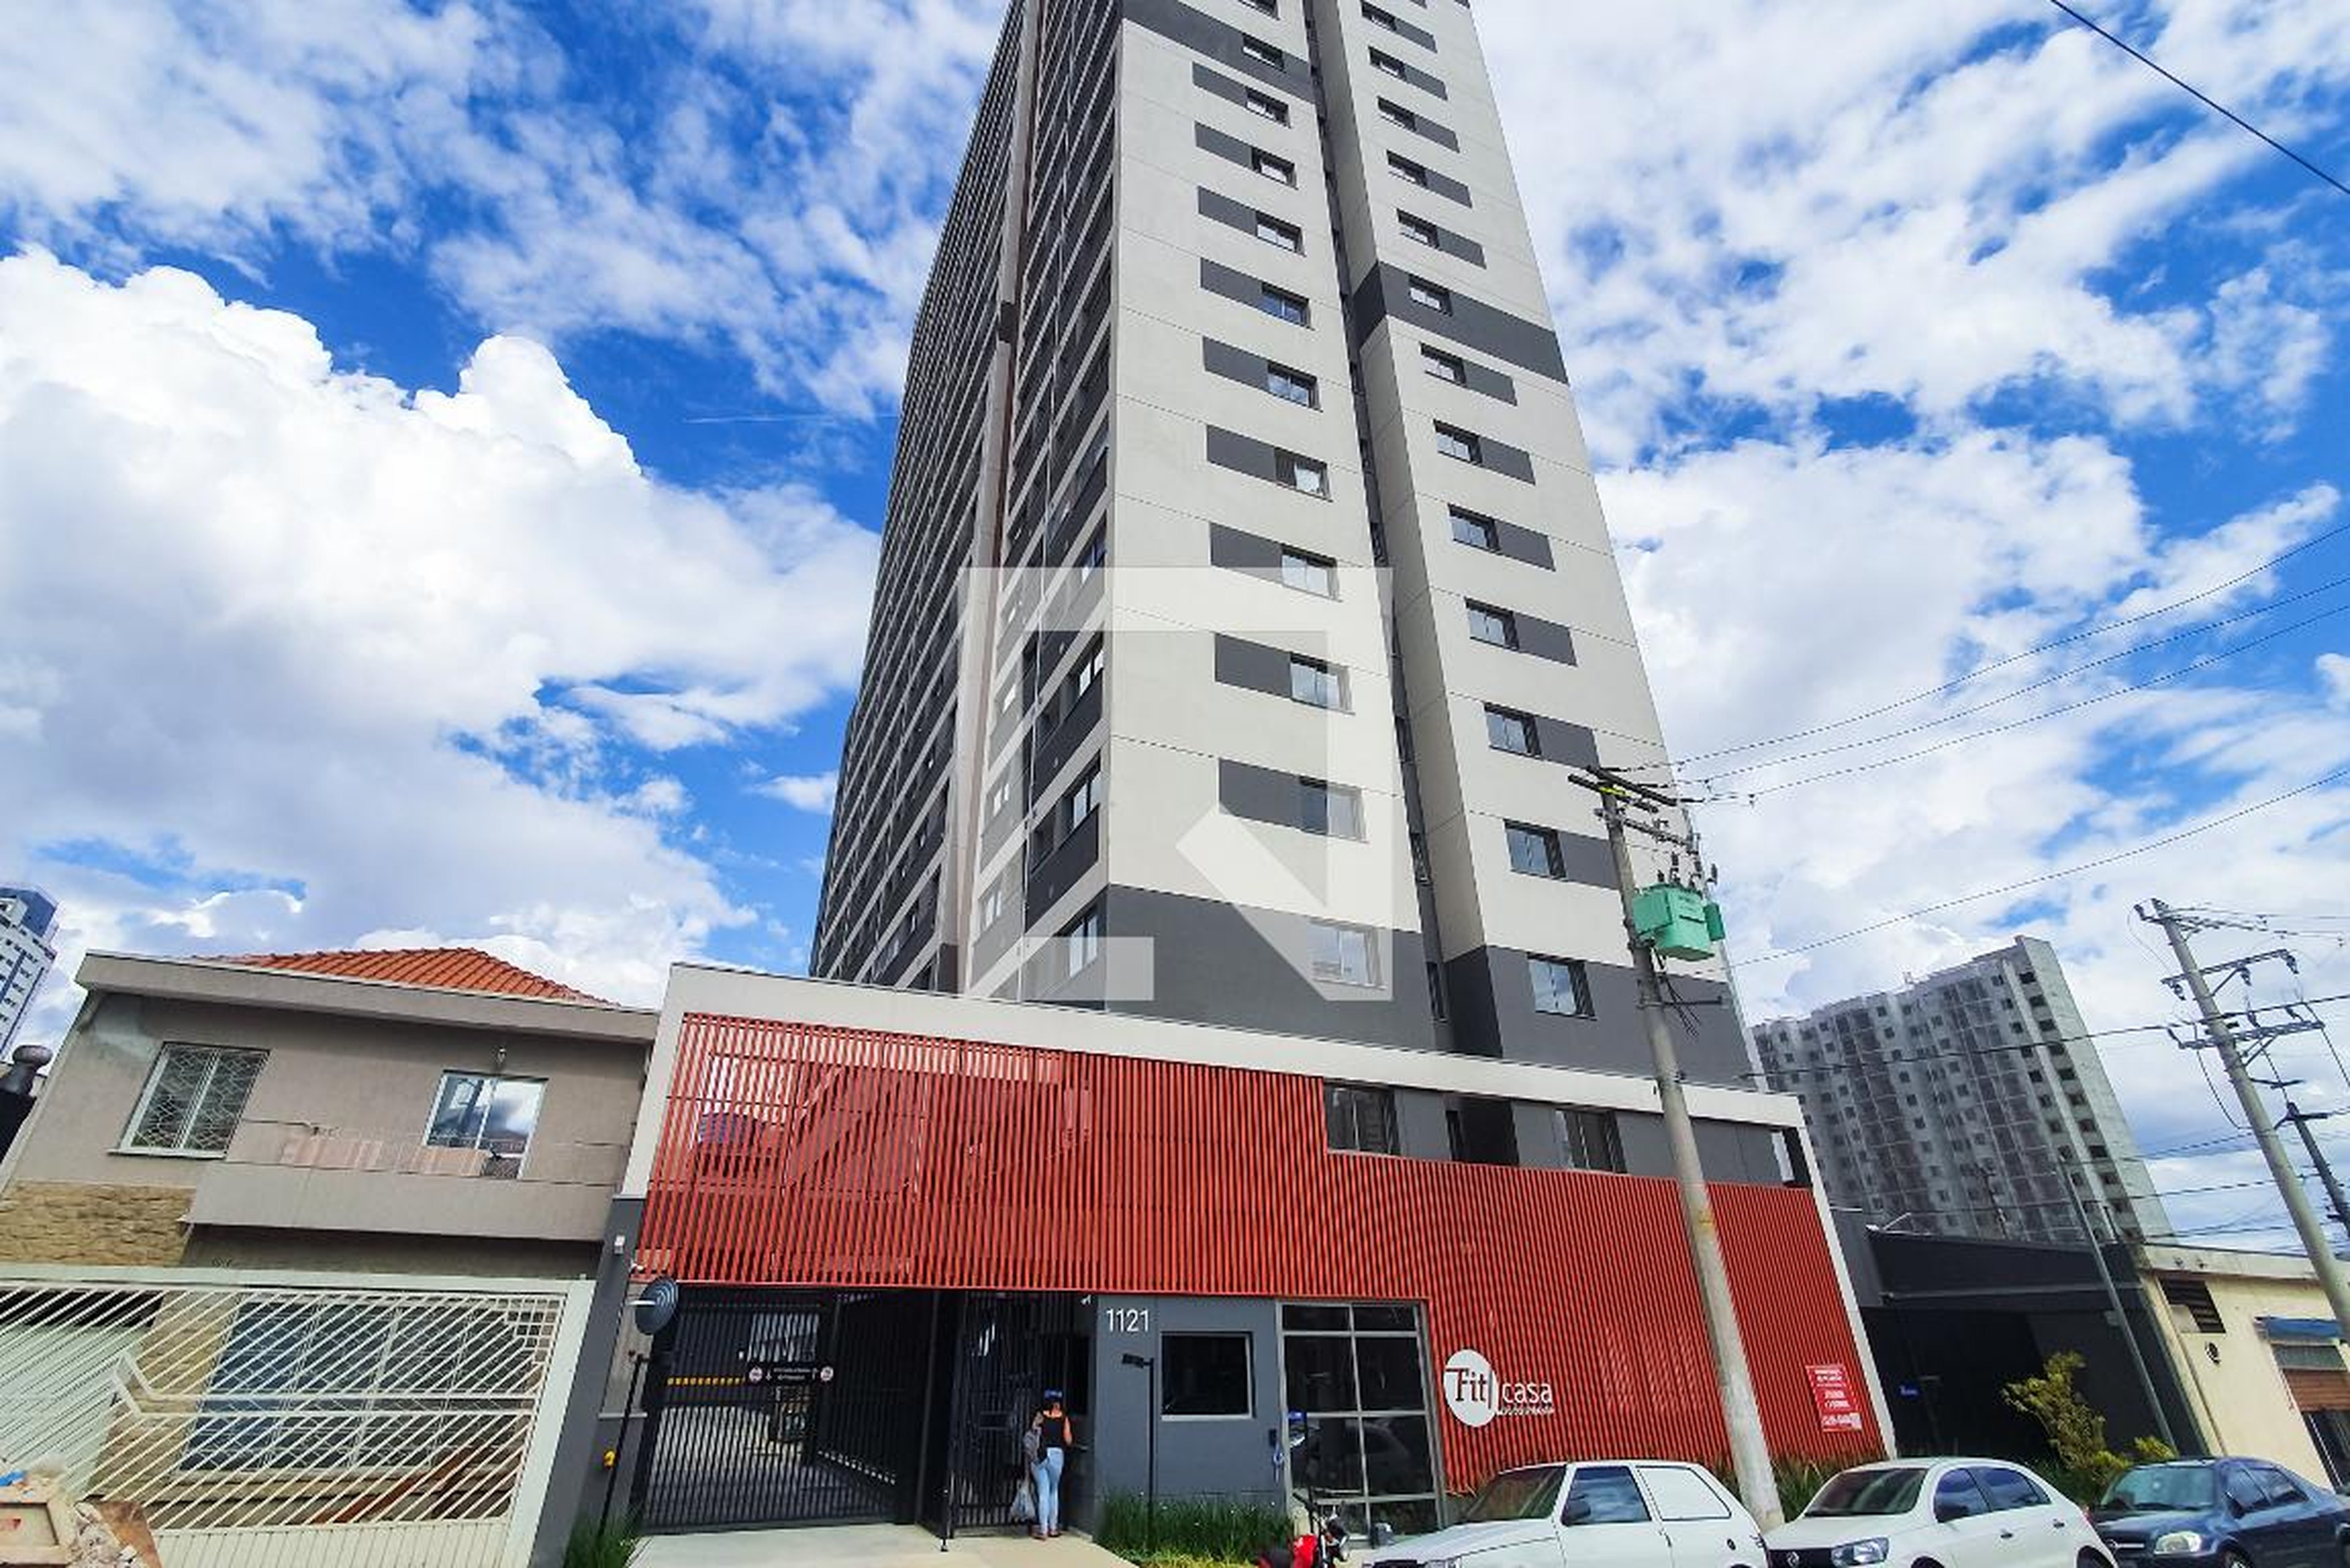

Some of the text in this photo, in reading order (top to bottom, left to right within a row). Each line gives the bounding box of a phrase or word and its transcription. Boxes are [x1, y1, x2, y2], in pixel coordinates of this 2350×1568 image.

[1106, 1308, 1149, 1332] 1121
[1445, 1368, 1552, 1403] Fit casa
